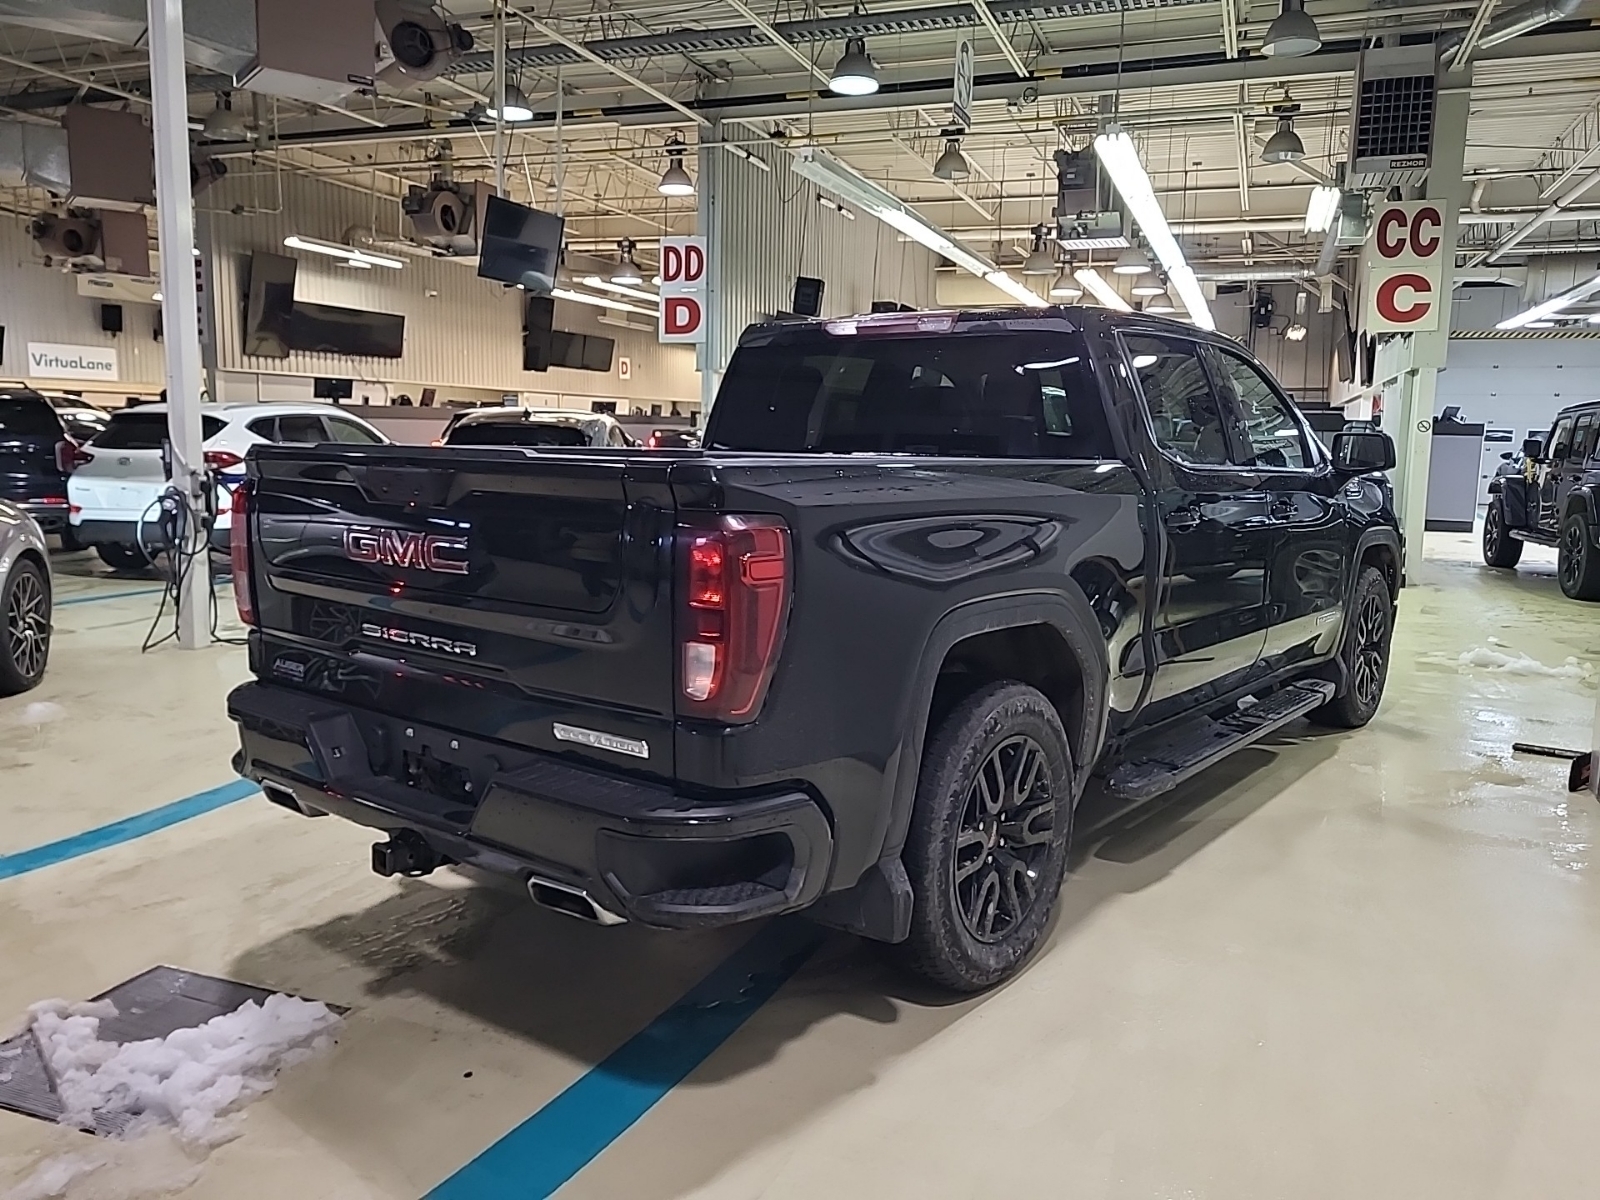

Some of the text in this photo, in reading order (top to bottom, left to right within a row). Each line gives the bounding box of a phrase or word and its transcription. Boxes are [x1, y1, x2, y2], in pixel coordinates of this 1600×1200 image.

[1376, 206, 1442, 259] CC
[663, 245, 704, 282] DD
[664, 297, 701, 334] D
[1376, 273, 1432, 323] C
[31, 352, 113, 371] VirtuaLane
[621, 361, 628, 375] D
[343, 525, 470, 575] GMC
[361, 623, 477, 656] SIERRA
